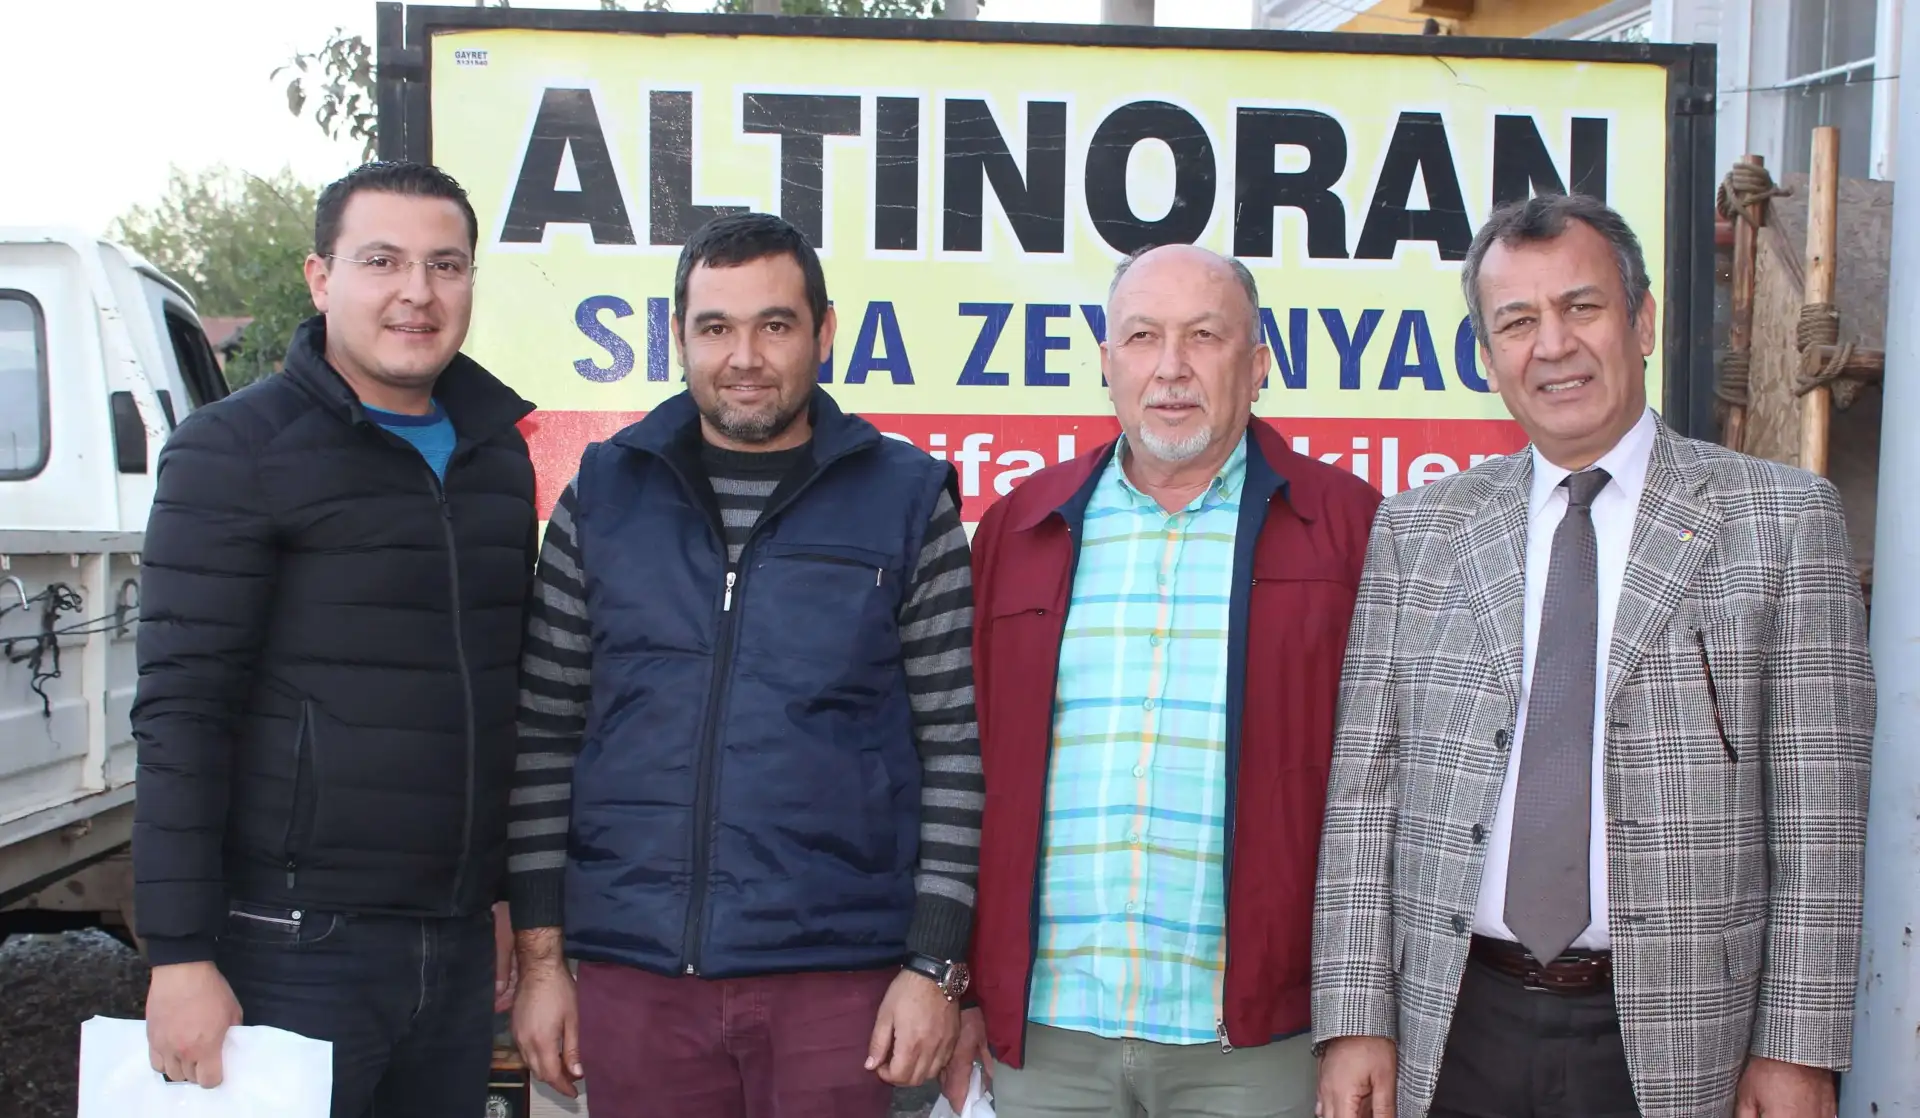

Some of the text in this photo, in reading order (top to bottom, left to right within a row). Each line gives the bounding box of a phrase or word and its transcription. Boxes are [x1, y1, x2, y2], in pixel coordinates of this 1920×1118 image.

[455, 51, 488, 60] GAYRET
[499, 87, 1608, 262] ALTINORAN
[573, 294, 916, 385] SIA
